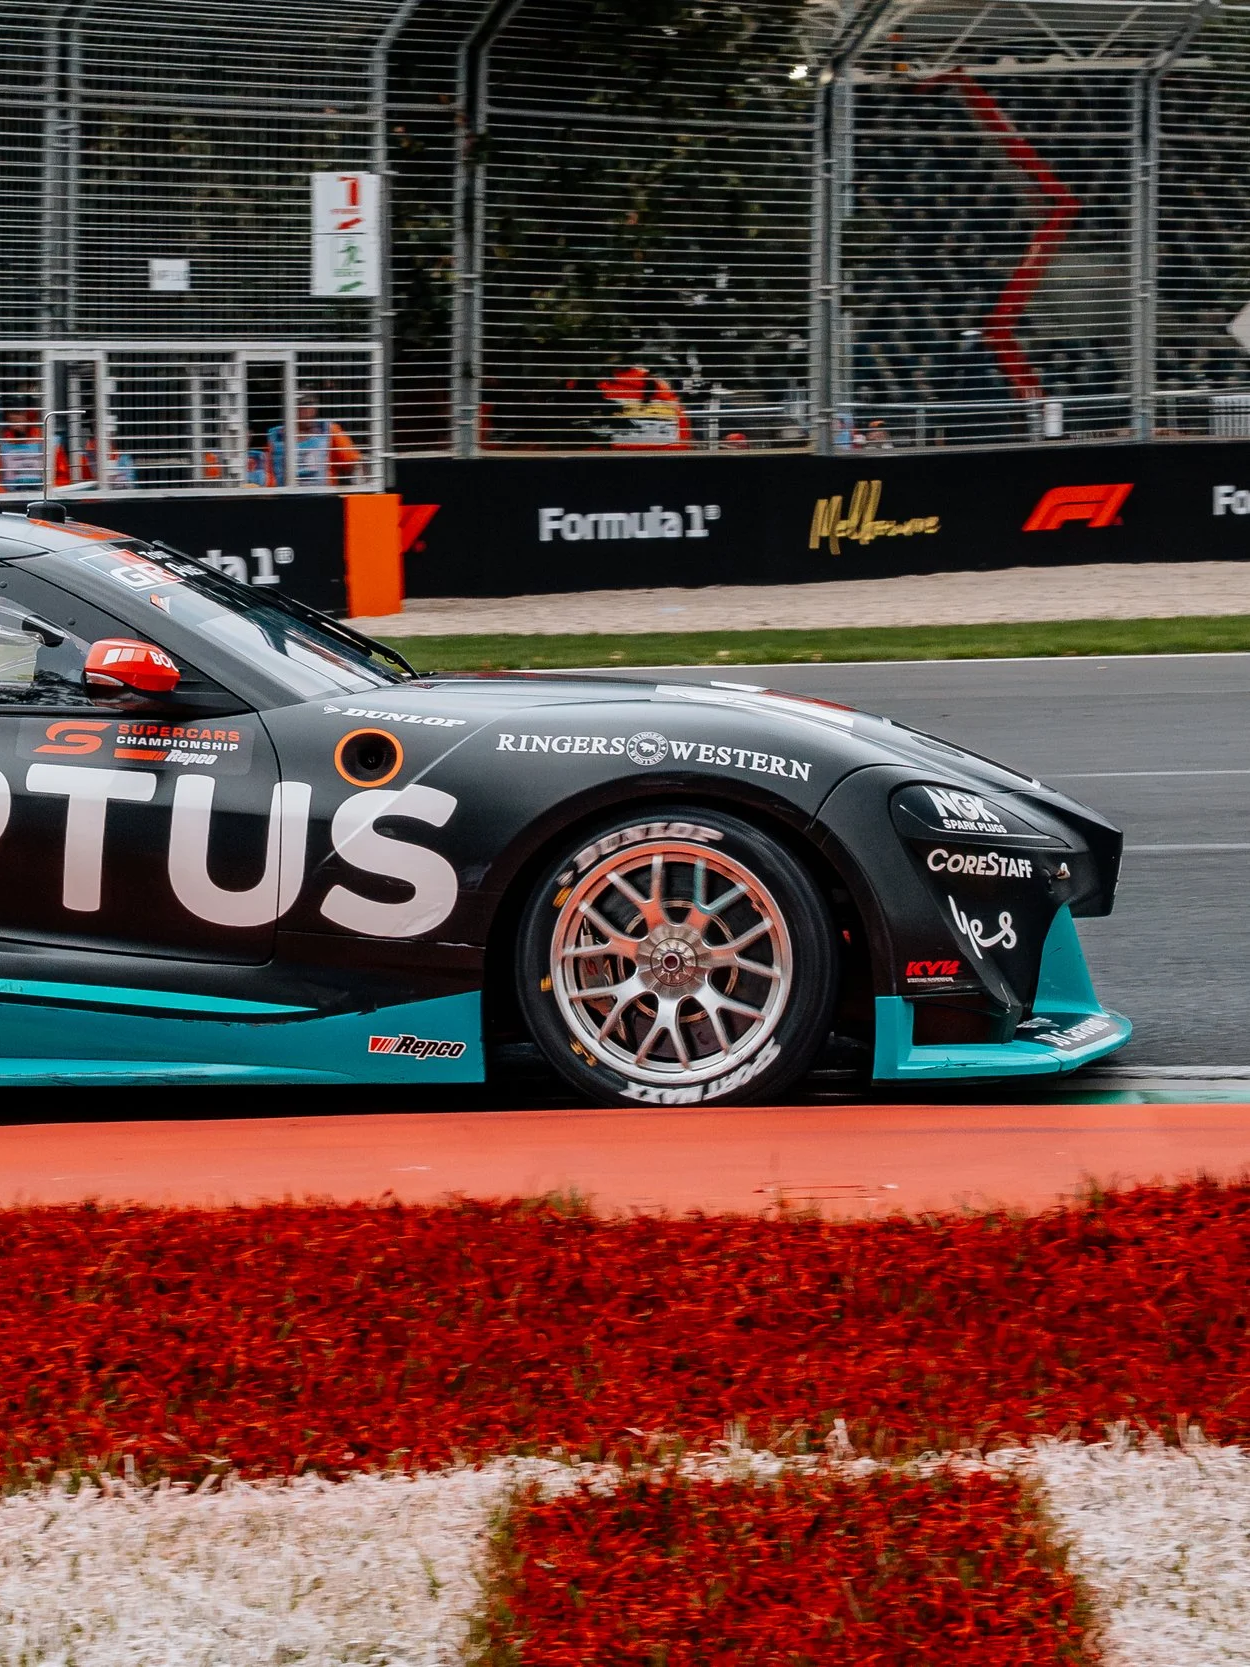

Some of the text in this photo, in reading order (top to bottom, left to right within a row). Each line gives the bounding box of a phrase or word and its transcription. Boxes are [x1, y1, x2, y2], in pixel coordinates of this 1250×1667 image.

[538, 506, 683, 541] Formula
[342, 708, 467, 727] DUNLOP
[118, 724, 240, 742] SUPERCARS
[116, 736, 239, 751] CHAMPIONSHIP
[165, 749, 218, 766] Repco
[496, 733, 812, 782] RINGERS WESTERN
[923, 786, 1000, 823] NGK
[943, 818, 1007, 833] SPARK PLUGS
[906, 961, 960, 976] KYB
[392, 1034, 466, 1059] Repco
